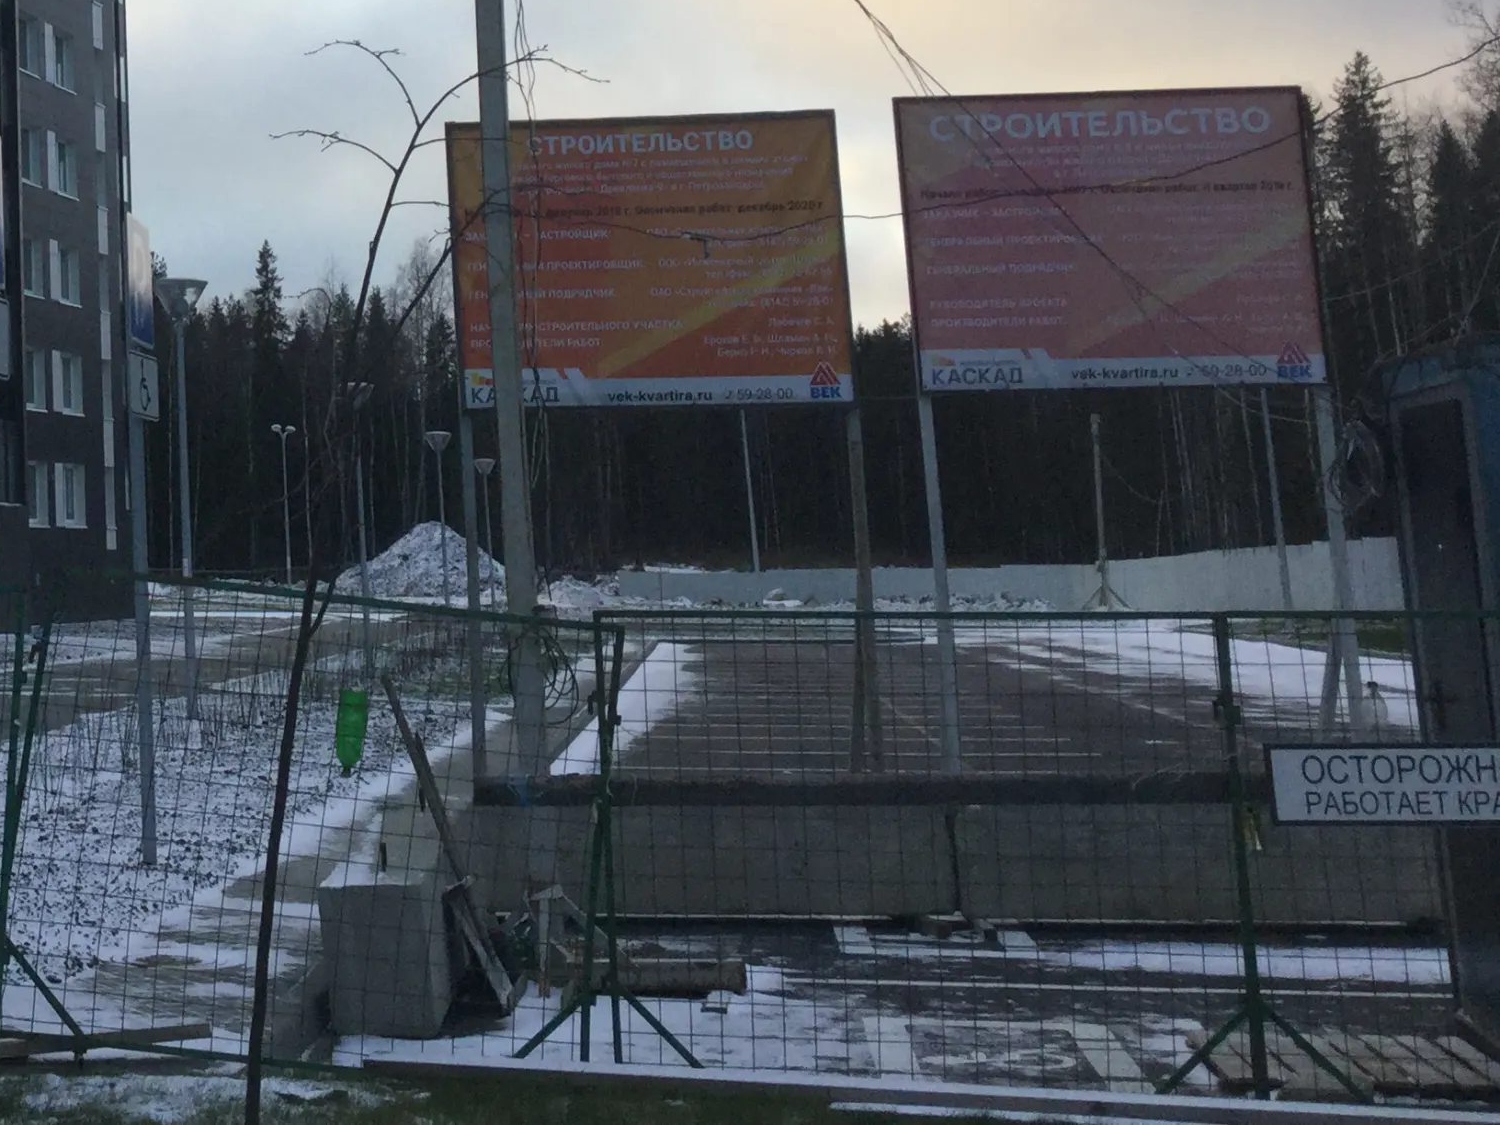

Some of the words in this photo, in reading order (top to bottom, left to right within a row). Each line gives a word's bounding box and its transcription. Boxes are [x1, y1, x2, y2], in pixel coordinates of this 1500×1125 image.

[929, 107, 1270, 142] СТРОИТЕЛЬСТВО
[527, 129, 754, 156] СТРОИТЕЛЬСТВО
[931, 367, 1025, 386] КАСКАД
[1071, 364, 1179, 381] vek-kvartira.ru
[1277, 364, 1313, 379] ВЕК
[471, 385, 560, 404] КАКАД
[607, 387, 713, 403] vek-kvartira.ru
[736, 386, 794, 400] 59-28-00
[810, 385, 843, 399] ВЕК
[1305, 790, 1449, 816] РАБОТАЕТ
